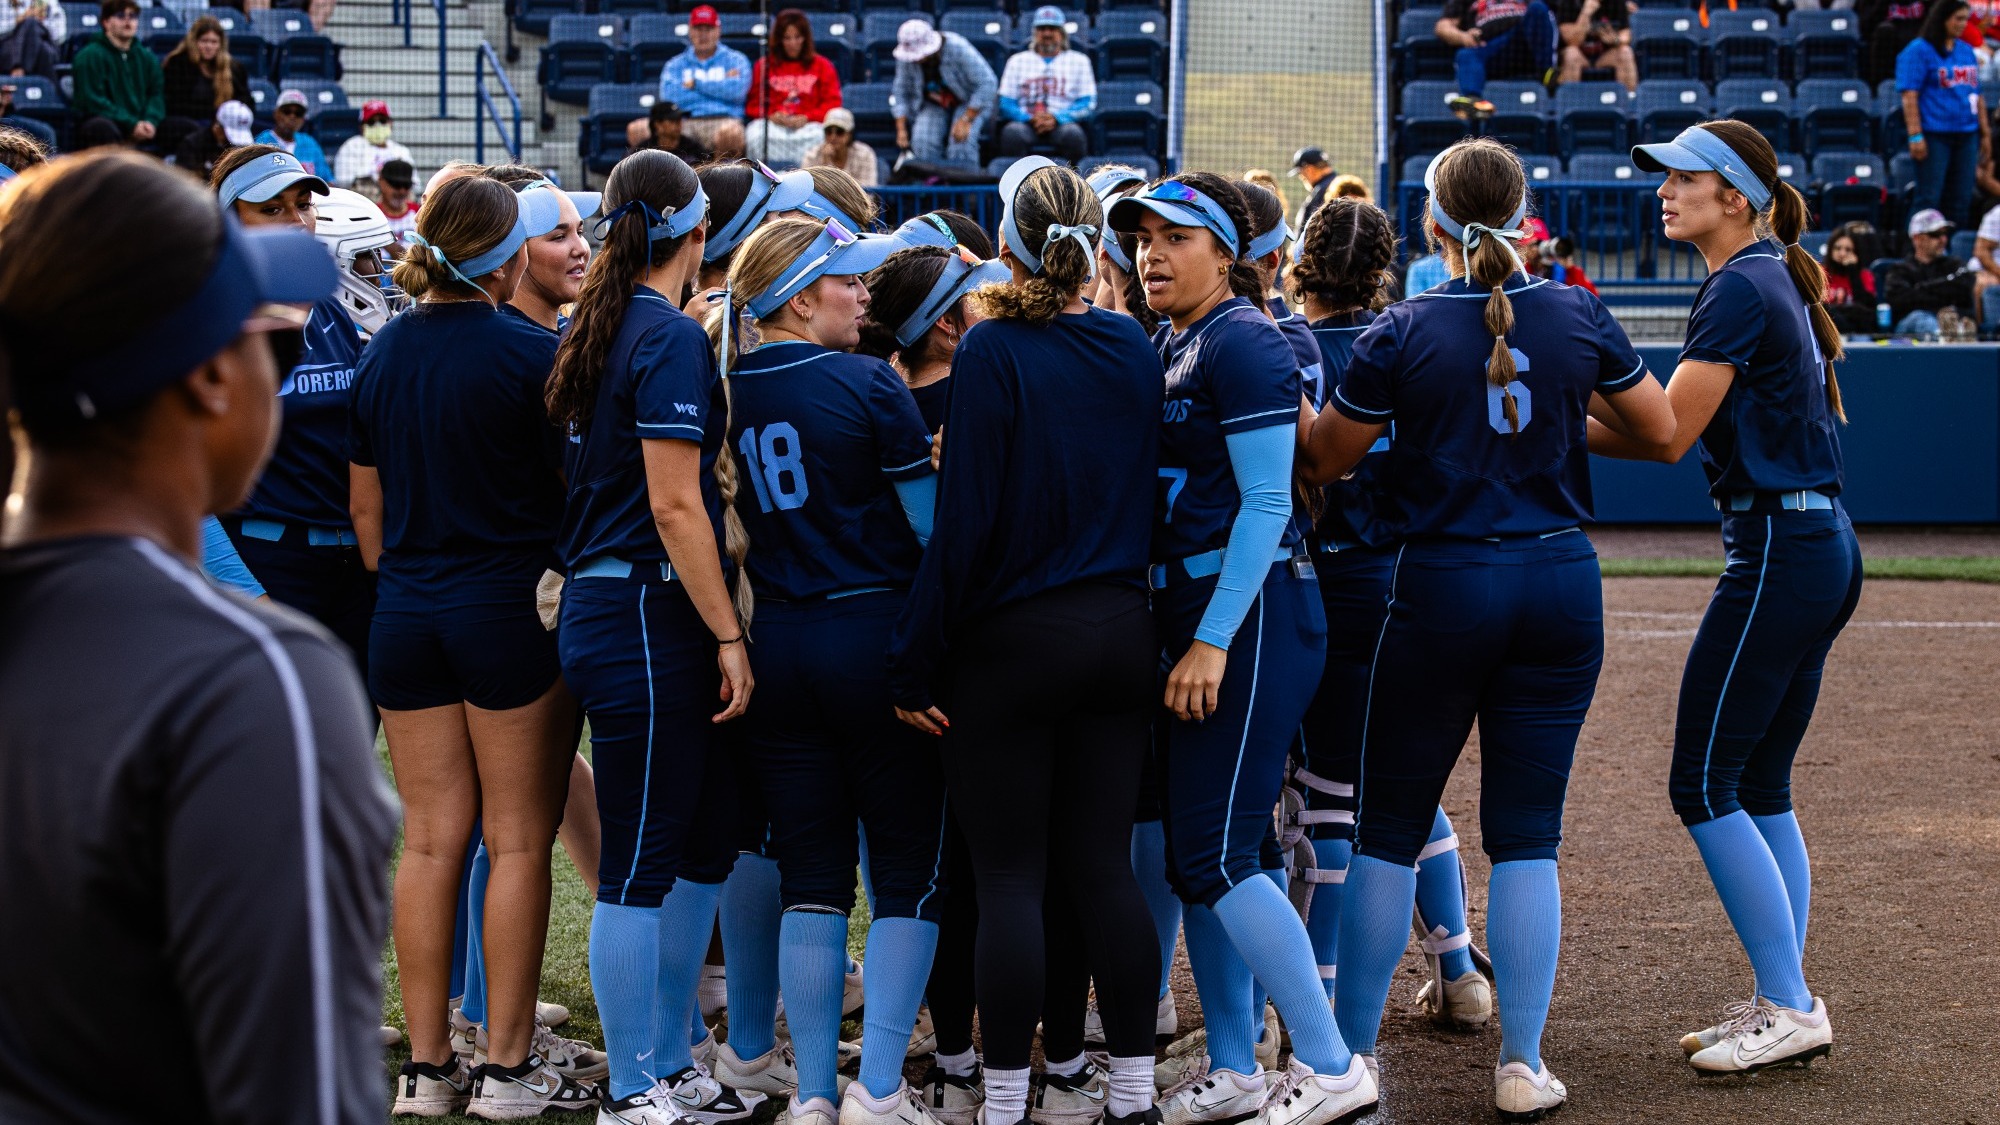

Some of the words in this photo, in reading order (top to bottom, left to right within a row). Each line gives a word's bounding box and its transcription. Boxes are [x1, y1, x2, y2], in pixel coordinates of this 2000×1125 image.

[1485, 348, 1532, 434] 6
[738, 421, 809, 513] 18
[1158, 467, 1188, 523] 7
